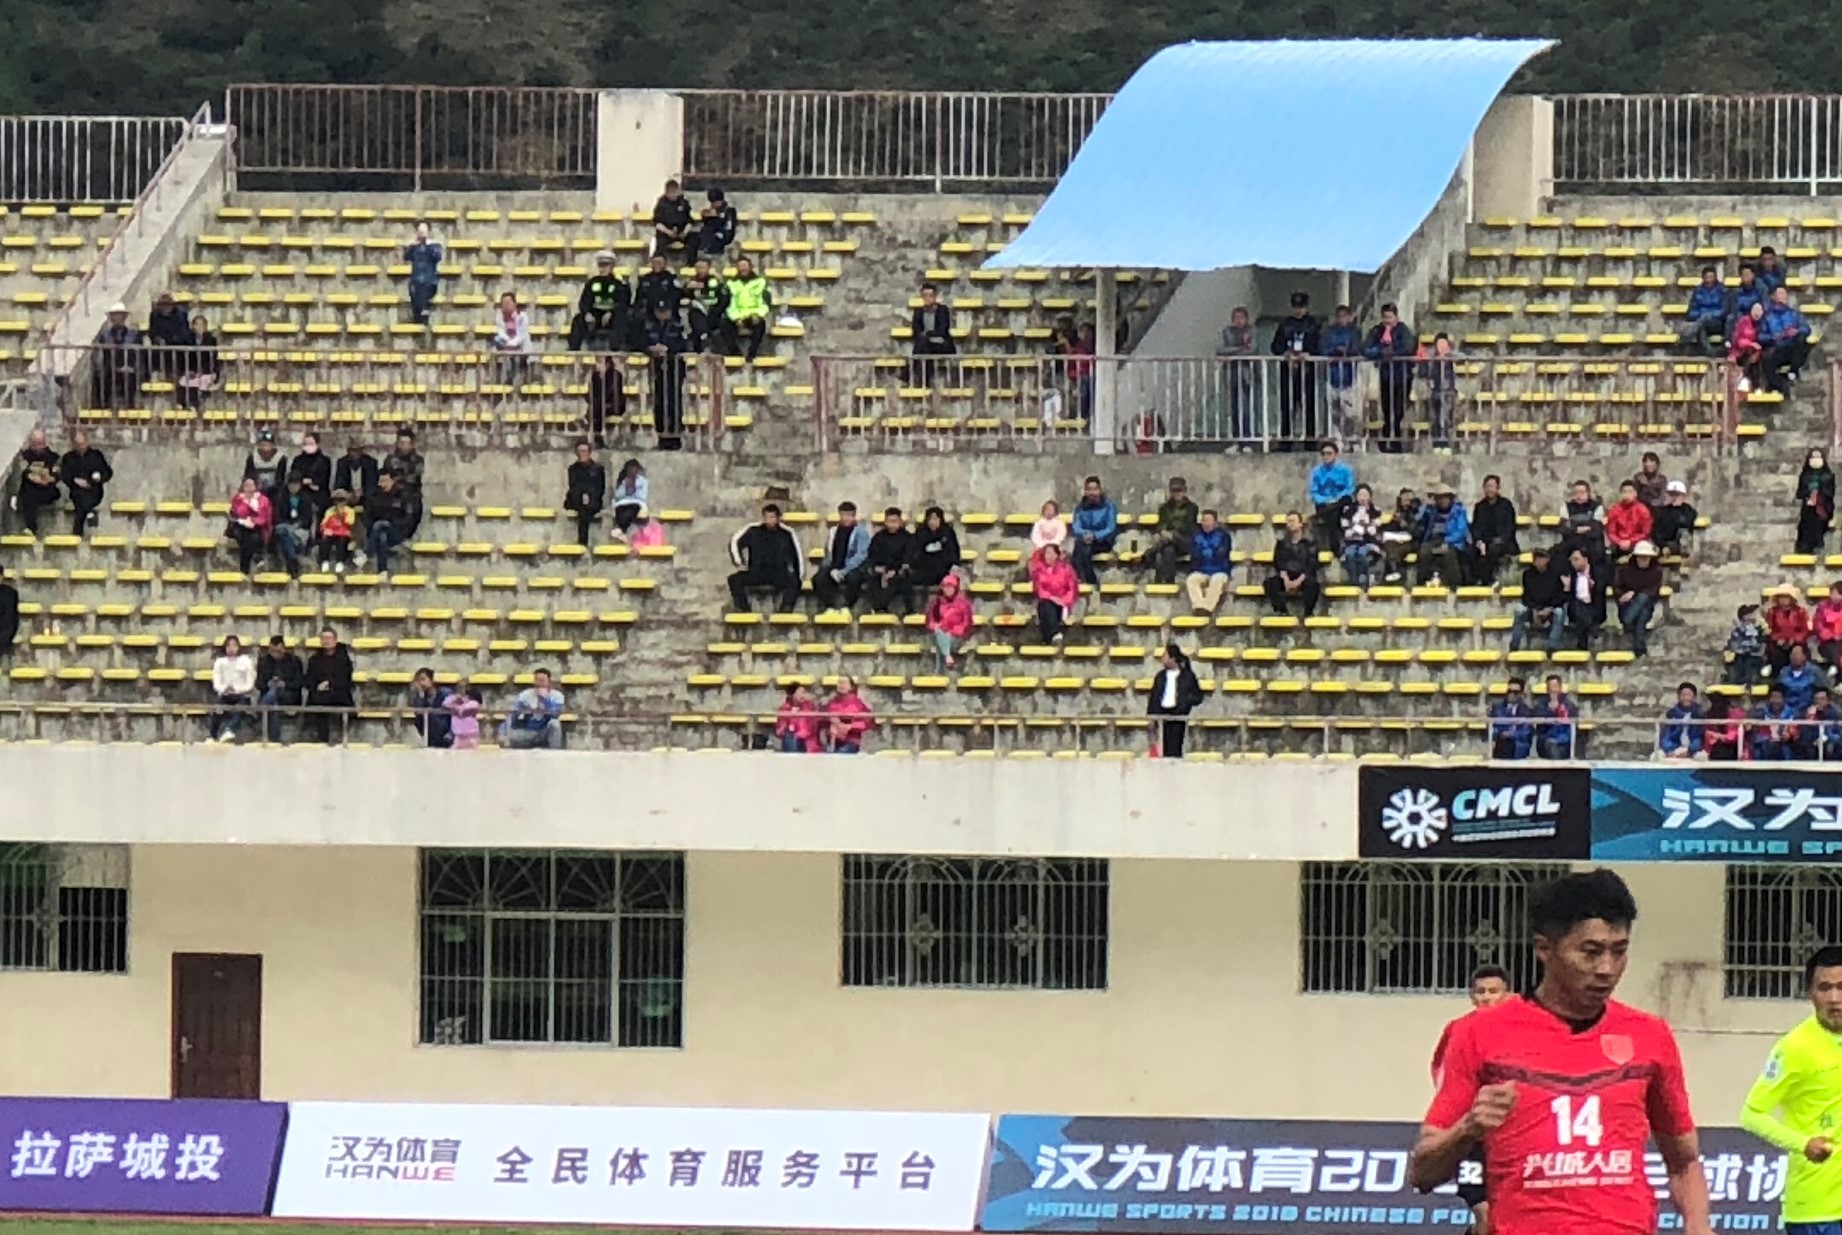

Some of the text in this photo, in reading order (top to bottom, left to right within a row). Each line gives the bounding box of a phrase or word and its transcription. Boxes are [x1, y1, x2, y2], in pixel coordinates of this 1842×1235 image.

[1452, 783, 1561, 820] CMCL
[1660, 838, 1790, 856] HANWE
[1551, 1095, 1603, 1146] 14
[11, 1129, 225, 1182] 拉萨城投
[329, 1135, 462, 1164] 汉为体育
[325, 1164, 457, 1182] HANWE
[493, 1145, 937, 1191] 全民体育服务平台
[1458, 1160, 1484, 1185] 32
[1026, 1202, 1119, 1219] HANWE
[1126, 1203, 1226, 1221] SPORTS
[1305, 1206, 1425, 1225] CHINESE
